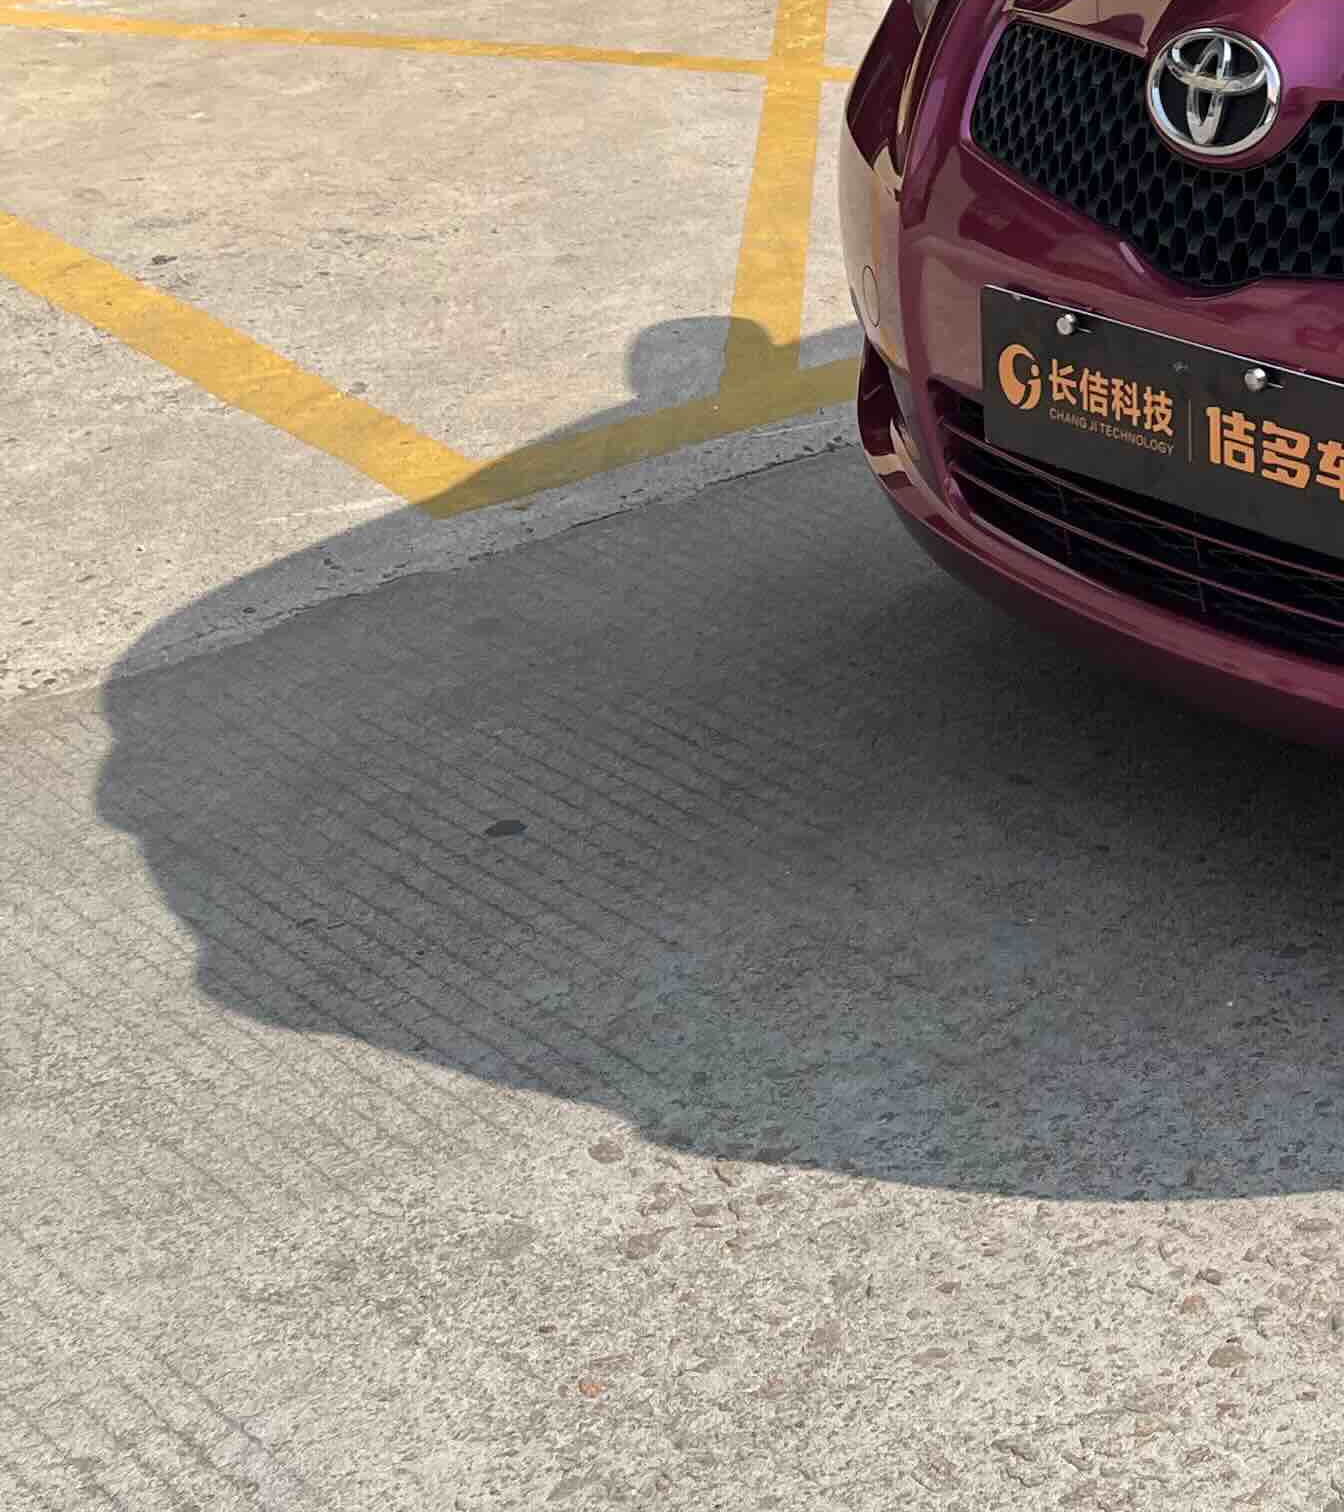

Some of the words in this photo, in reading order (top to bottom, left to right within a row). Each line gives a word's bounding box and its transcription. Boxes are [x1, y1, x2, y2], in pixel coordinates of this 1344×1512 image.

[1048, 358, 1174, 437] 长佶科技
[1048, 407, 1088, 430] CHANG
[1099, 422, 1175, 456] TECHNOLOGY
